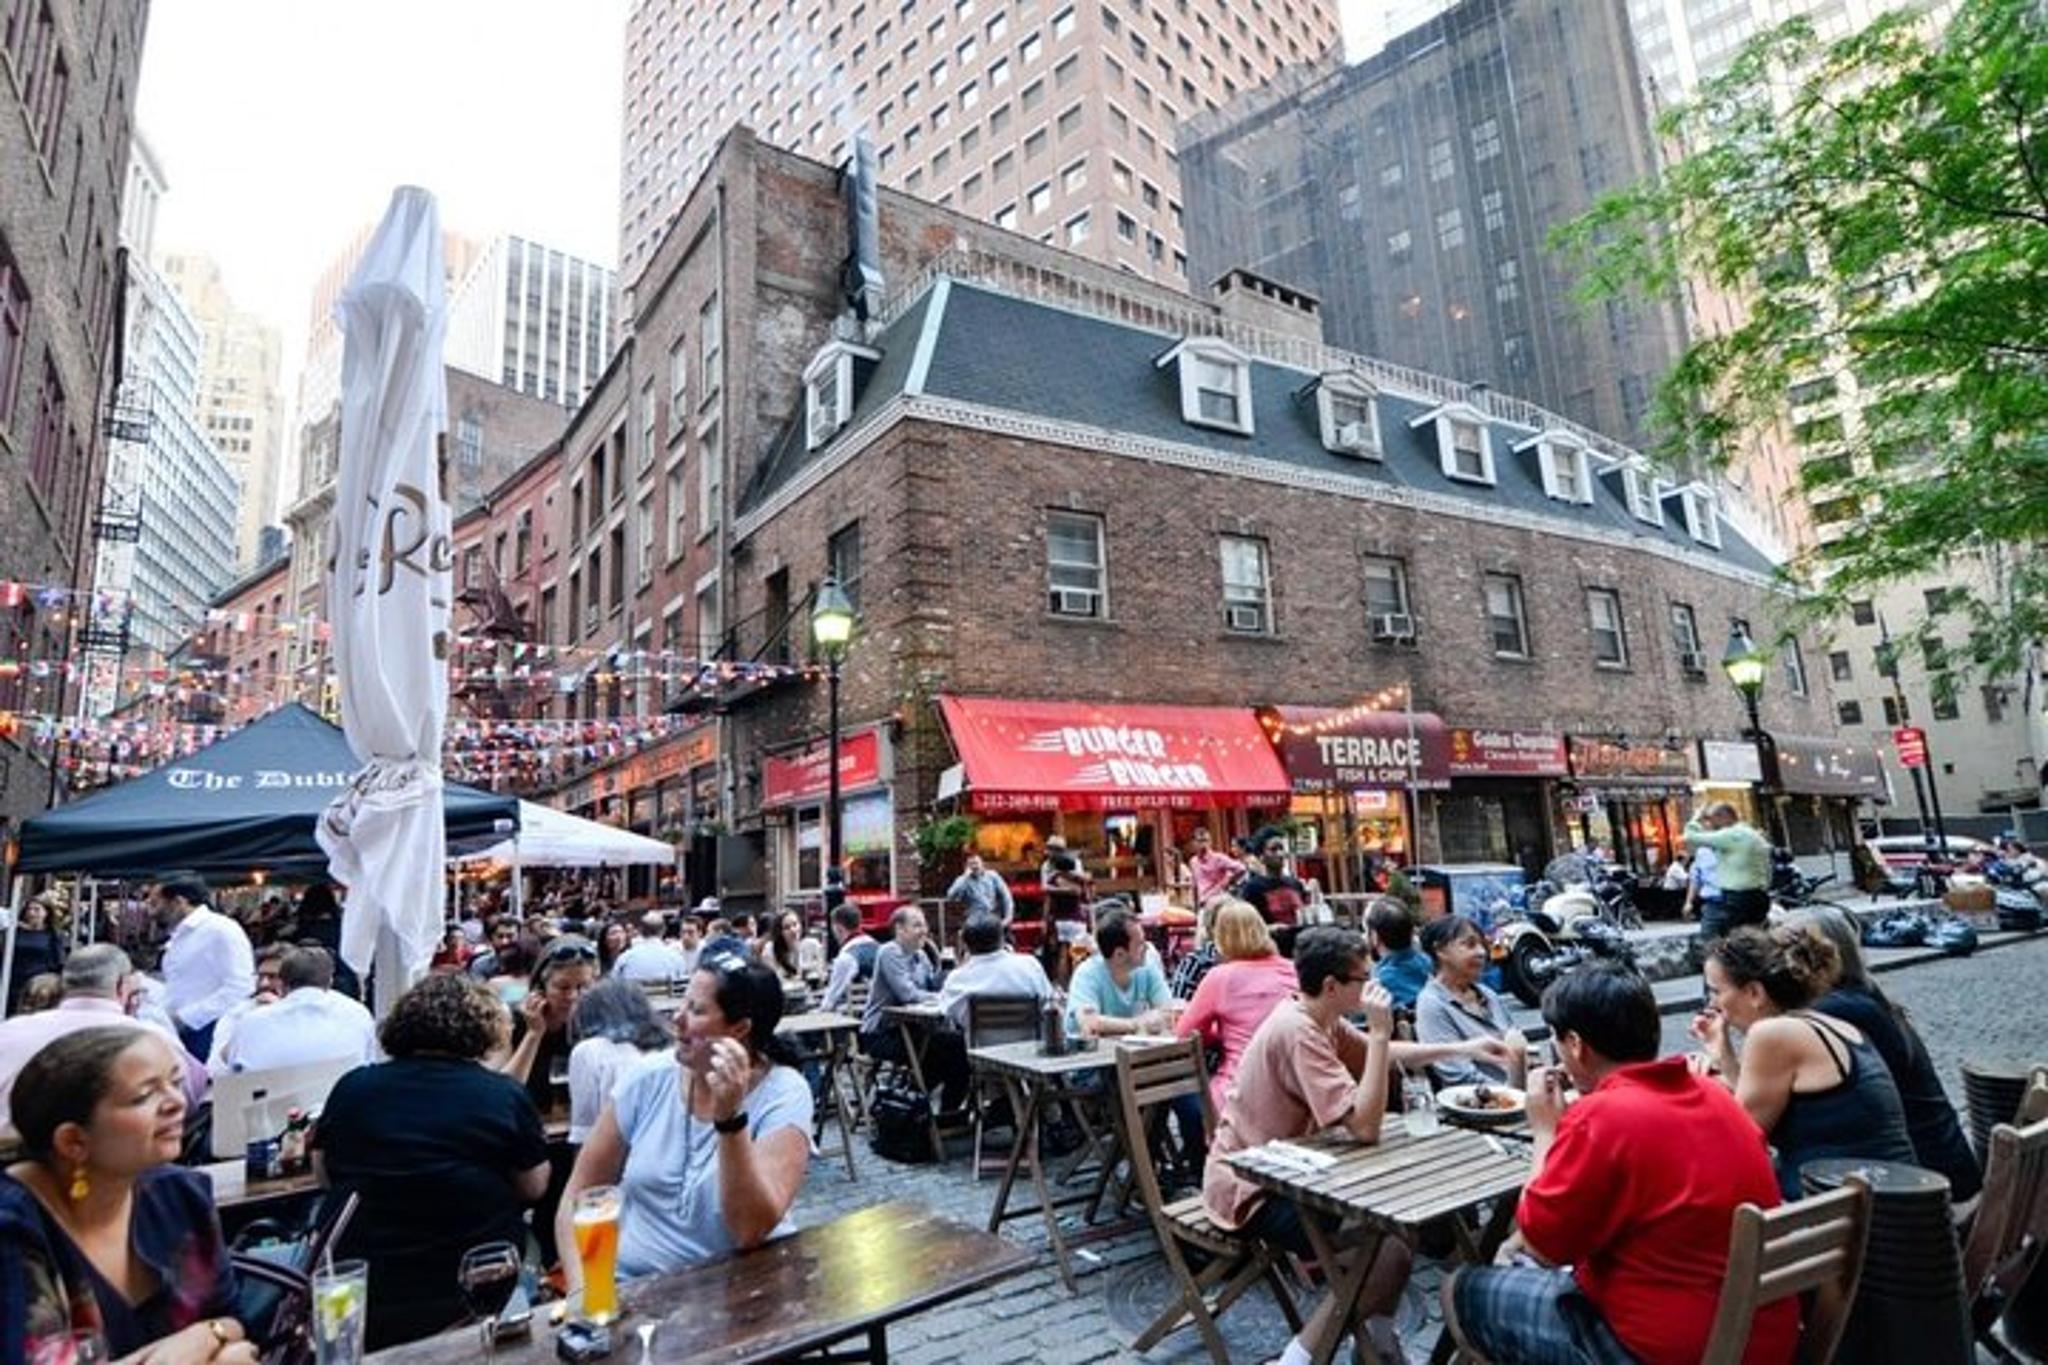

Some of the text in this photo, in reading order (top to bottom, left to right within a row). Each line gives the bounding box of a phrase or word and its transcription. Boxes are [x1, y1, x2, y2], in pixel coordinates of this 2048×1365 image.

[1062, 725, 1167, 758] BURGER
[1316, 735, 1422, 766] TERRACE
[167, 768, 243, 790] The
[1107, 759, 1213, 788] BURGER
[1336, 768, 1366, 783] FISH
[1368, 769, 1377, 782] &
